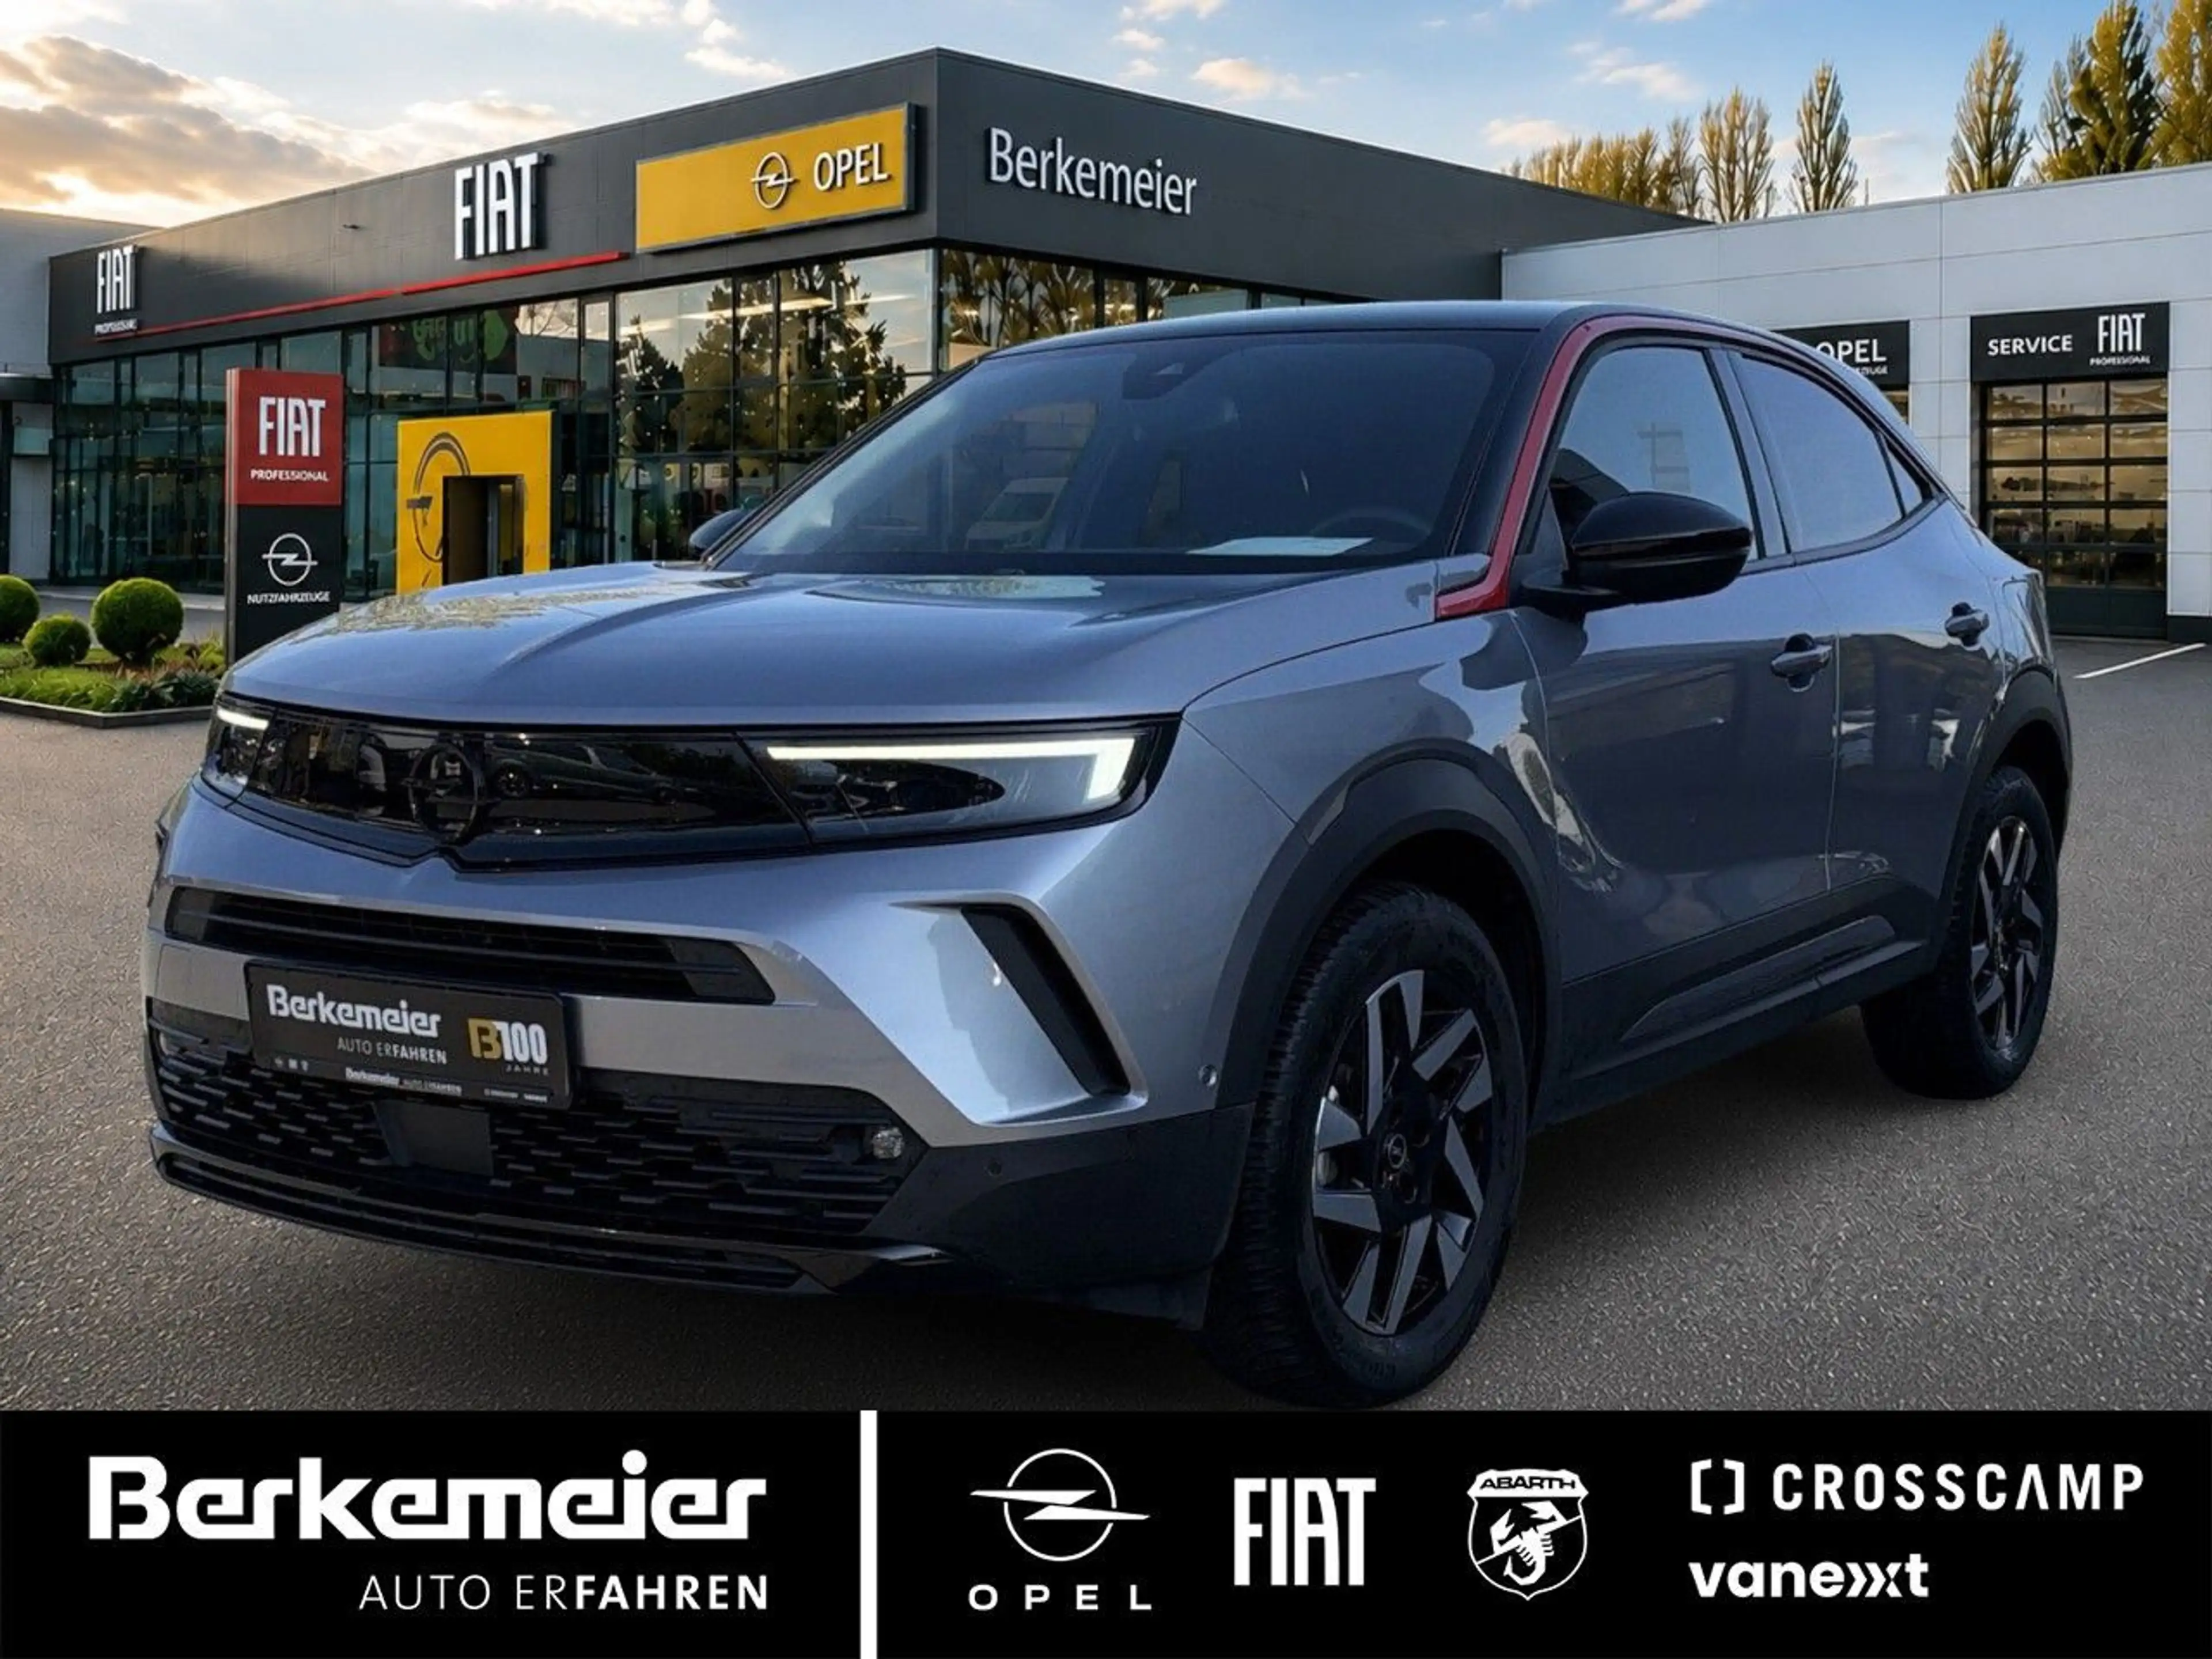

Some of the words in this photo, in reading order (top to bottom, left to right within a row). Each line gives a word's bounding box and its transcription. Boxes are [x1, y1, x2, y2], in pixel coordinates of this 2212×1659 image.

[814, 143, 888, 191] OPEL
[990, 127, 1197, 215] Berkemeier
[454, 153, 539, 259] FIAT
[97, 245, 134, 314] FIAT
[1987, 335, 2073, 356] SERVICE
[2097, 313, 2146, 353] FIAT
[259, 396, 326, 457] FIAT
[250, 469, 328, 482] PROFESSIONAL
[266, 984, 441, 1037] Berkemeier
[337, 1037, 372, 1055] AUTO
[376, 1041, 447, 1065] ERFAHREN
